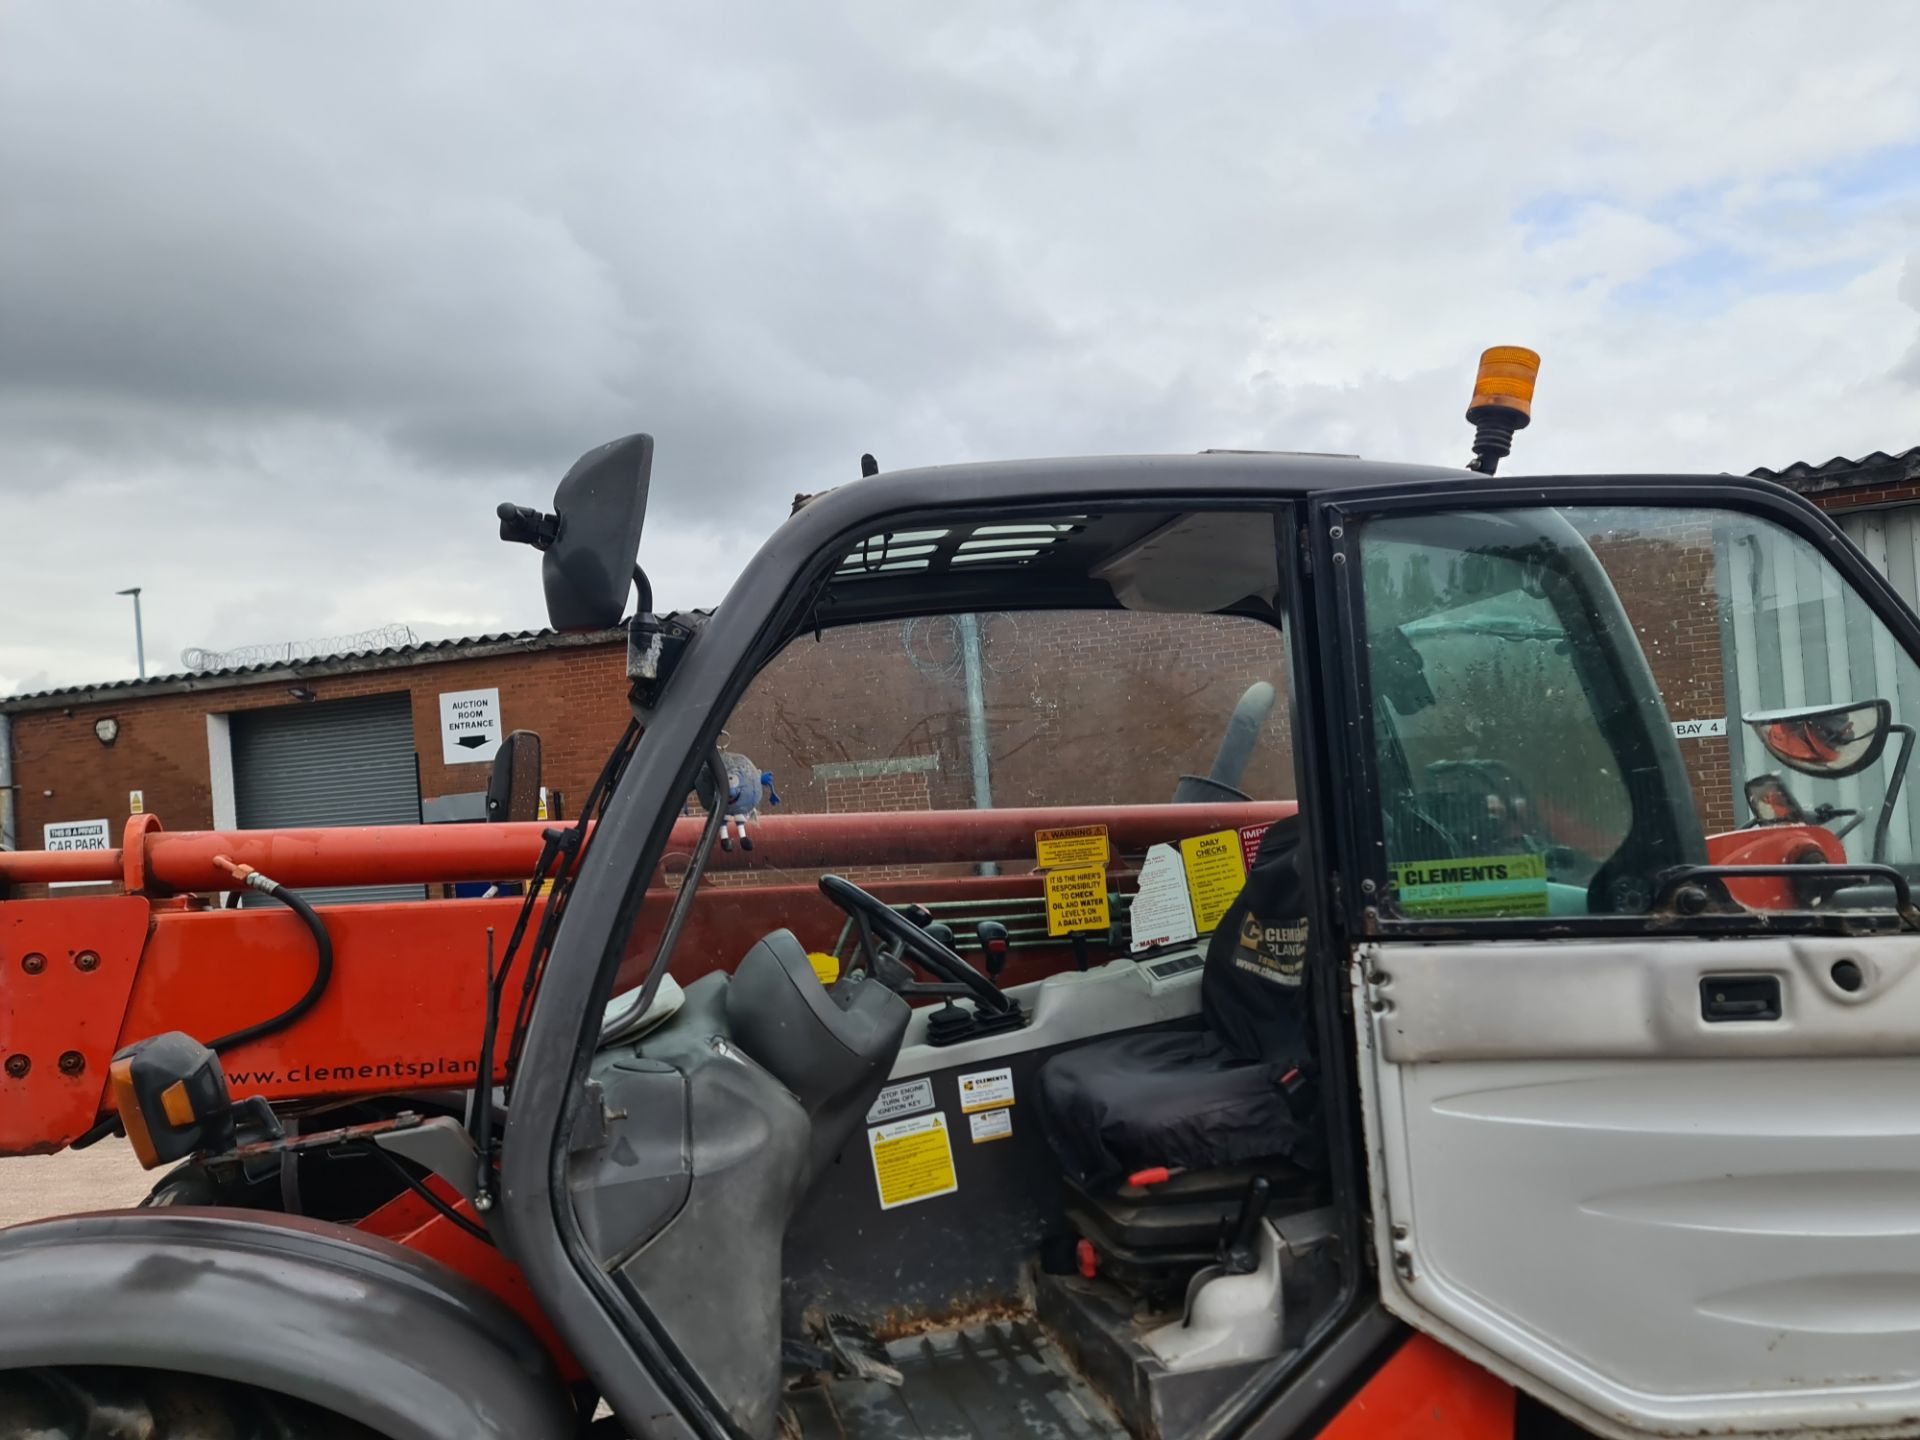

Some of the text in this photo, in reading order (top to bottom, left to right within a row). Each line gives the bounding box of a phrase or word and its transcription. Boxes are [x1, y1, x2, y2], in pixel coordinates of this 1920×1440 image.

[452, 700, 488, 710] AUCTION
[458, 710, 483, 719] ROOM
[449, 719, 494, 731] ENTRANCE
[1677, 722, 1718, 735] BAY 4
[1052, 828, 1092, 839] WARNING
[49, 837, 105, 851] CAR PARK
[1200, 838, 1219, 848] DAILY
[1196, 845, 1227, 857] CHECKS
[1050, 876, 1056, 884] IT
[1077, 872, 1101, 880] HIRER'S
[1404, 865, 1508, 885] CLEMENTS
[1052, 881, 1100, 893] RESPONSIBILITY
[1408, 886, 1464, 899] PLANT
[1070, 890, 1094, 898] CHECK
[1053, 902, 1064, 910] OIL
[1080, 898, 1103, 907] WATER
[1062, 909, 1086, 918] LEVEL'S
[1064, 917, 1082, 926] DAILY
[1084, 916, 1102, 924] BASIS
[1140, 936, 1169, 947] MANITOU
[975, 1074, 1008, 1084] CLEMENTS
[881, 1084, 924, 1099] STOP ENGINE
[882, 1099, 900, 1107] TURN
[877, 1104, 906, 1115] IGNITION
